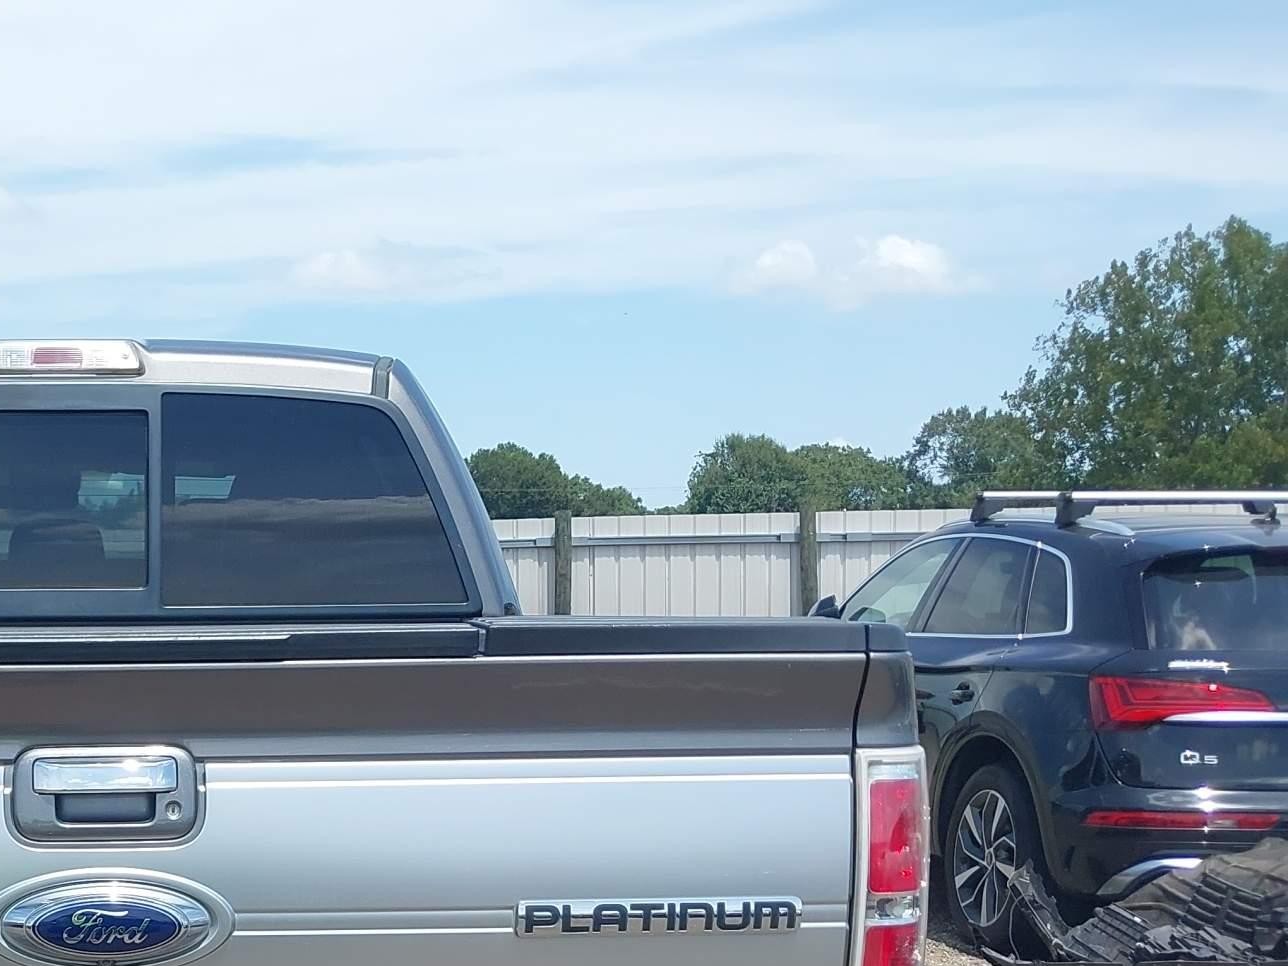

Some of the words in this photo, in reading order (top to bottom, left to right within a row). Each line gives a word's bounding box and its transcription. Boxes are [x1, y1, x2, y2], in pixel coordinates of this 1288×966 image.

[1180, 751, 1219, 764] Q5
[63, 908, 151, 944] Ford
[524, 901, 797, 933] PLATINUM
